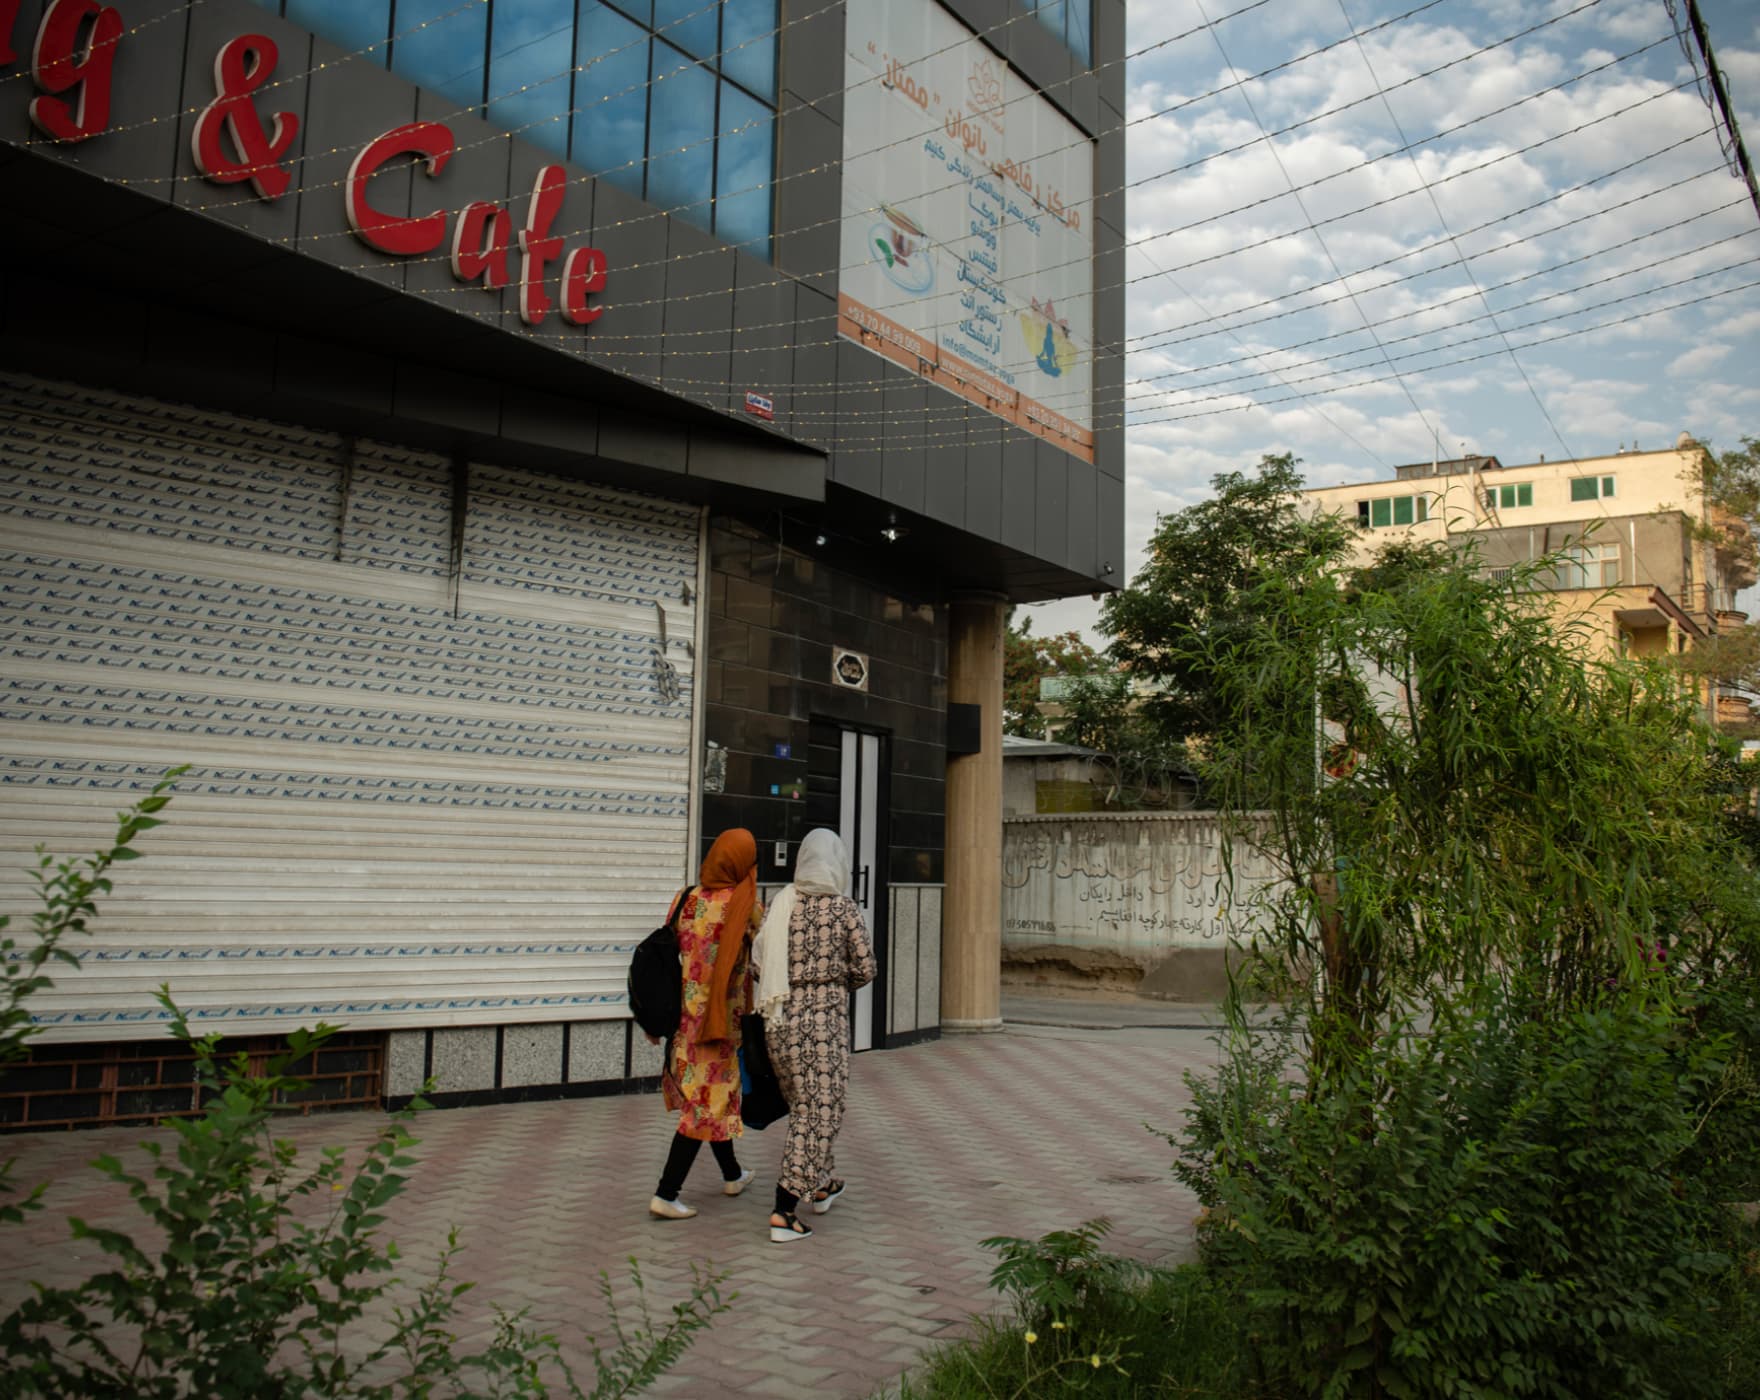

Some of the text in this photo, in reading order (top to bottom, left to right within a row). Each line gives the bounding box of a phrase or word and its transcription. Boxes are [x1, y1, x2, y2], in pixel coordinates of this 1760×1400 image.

[944, 106, 988, 160] بانوان
[191, 33, 300, 202] &
[346, 121, 608, 326] Cafe
[1046, 184, 1081, 233] مرکز
